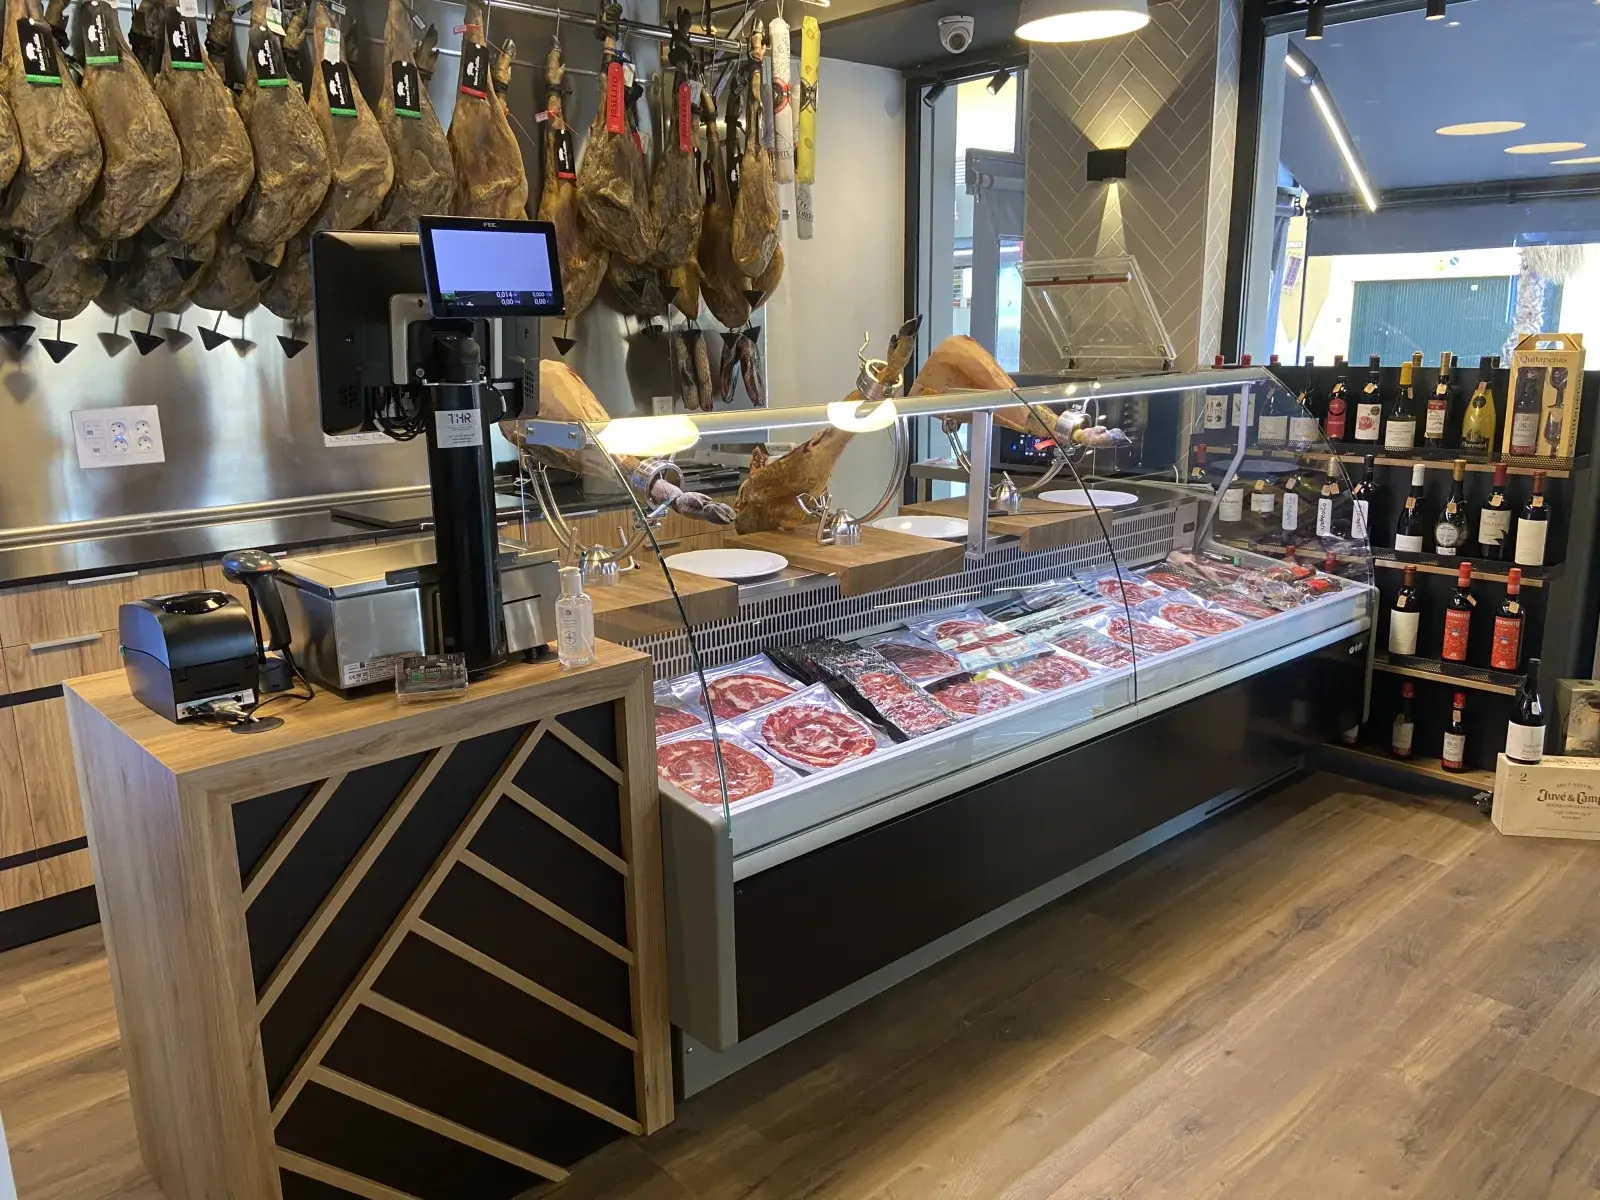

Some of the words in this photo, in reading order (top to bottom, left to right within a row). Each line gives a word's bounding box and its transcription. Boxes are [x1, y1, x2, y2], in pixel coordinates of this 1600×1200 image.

[610, 77, 618, 118] JOSELITO
[496, 291, 513, 299] 0,014
[448, 412, 472, 424] THR
[1520, 773, 1527, 782] 2
[1537, 788, 1566, 802] Juvé
[1567, 793, 1575, 802] &
